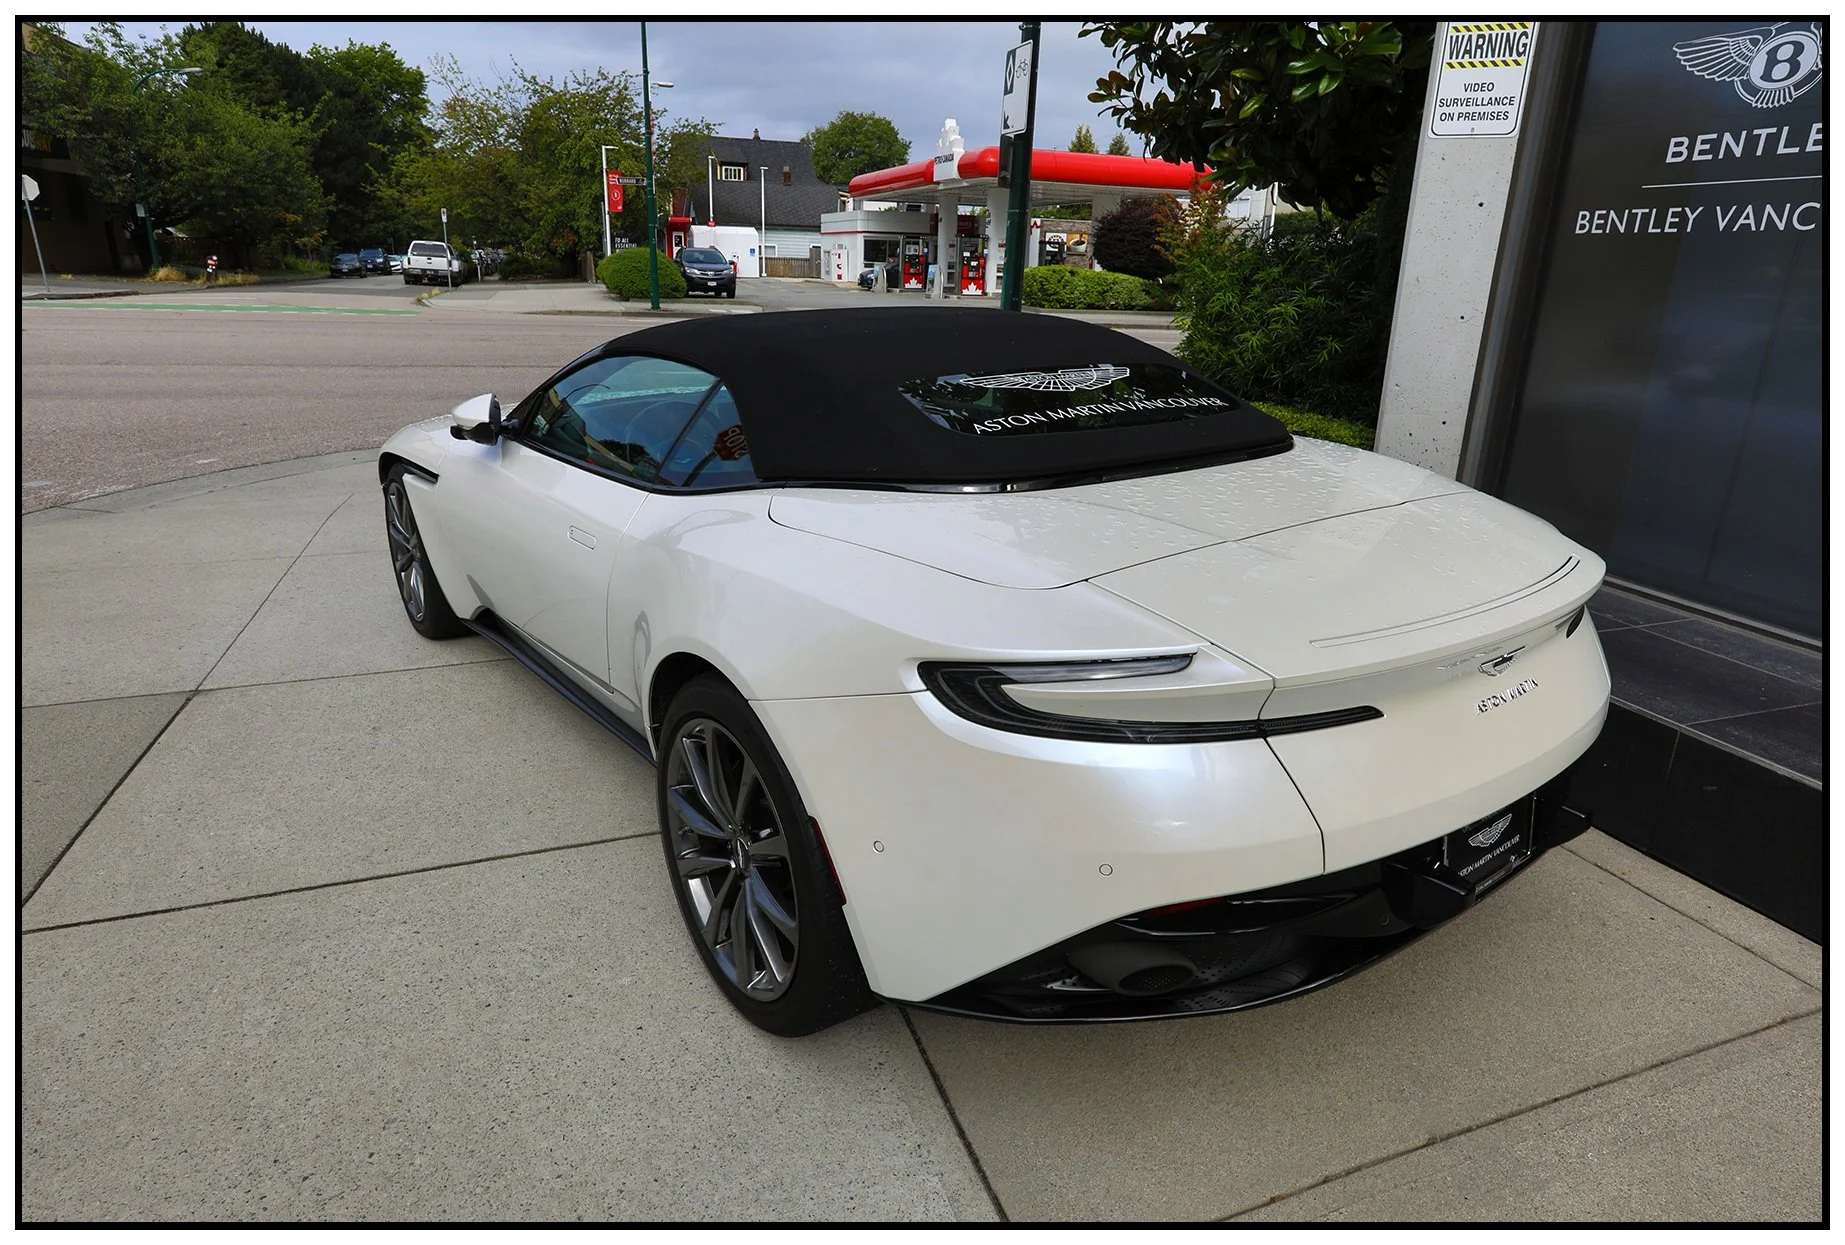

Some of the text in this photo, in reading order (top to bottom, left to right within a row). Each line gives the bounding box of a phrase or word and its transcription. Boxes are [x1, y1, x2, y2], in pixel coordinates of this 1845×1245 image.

[1448, 31, 1529, 60] WARNING
[1759, 40, 1806, 83] B
[1438, 96, 1516, 108] SURVEILLANCE
[1463, 82, 1495, 93] VIDEO
[1440, 111, 1510, 122] ON PREMISES
[1665, 122, 1822, 163] BENTLE
[1574, 202, 1821, 234] BENTLEY VANC
[973, 397, 1229, 434] ASTON MARTIN VANCOUVER
[1475, 677, 1539, 714] ASTON MARTIN
[1474, 852, 1493, 870] MARTIN
[1493, 834, 1520, 857] VANCOUVER
